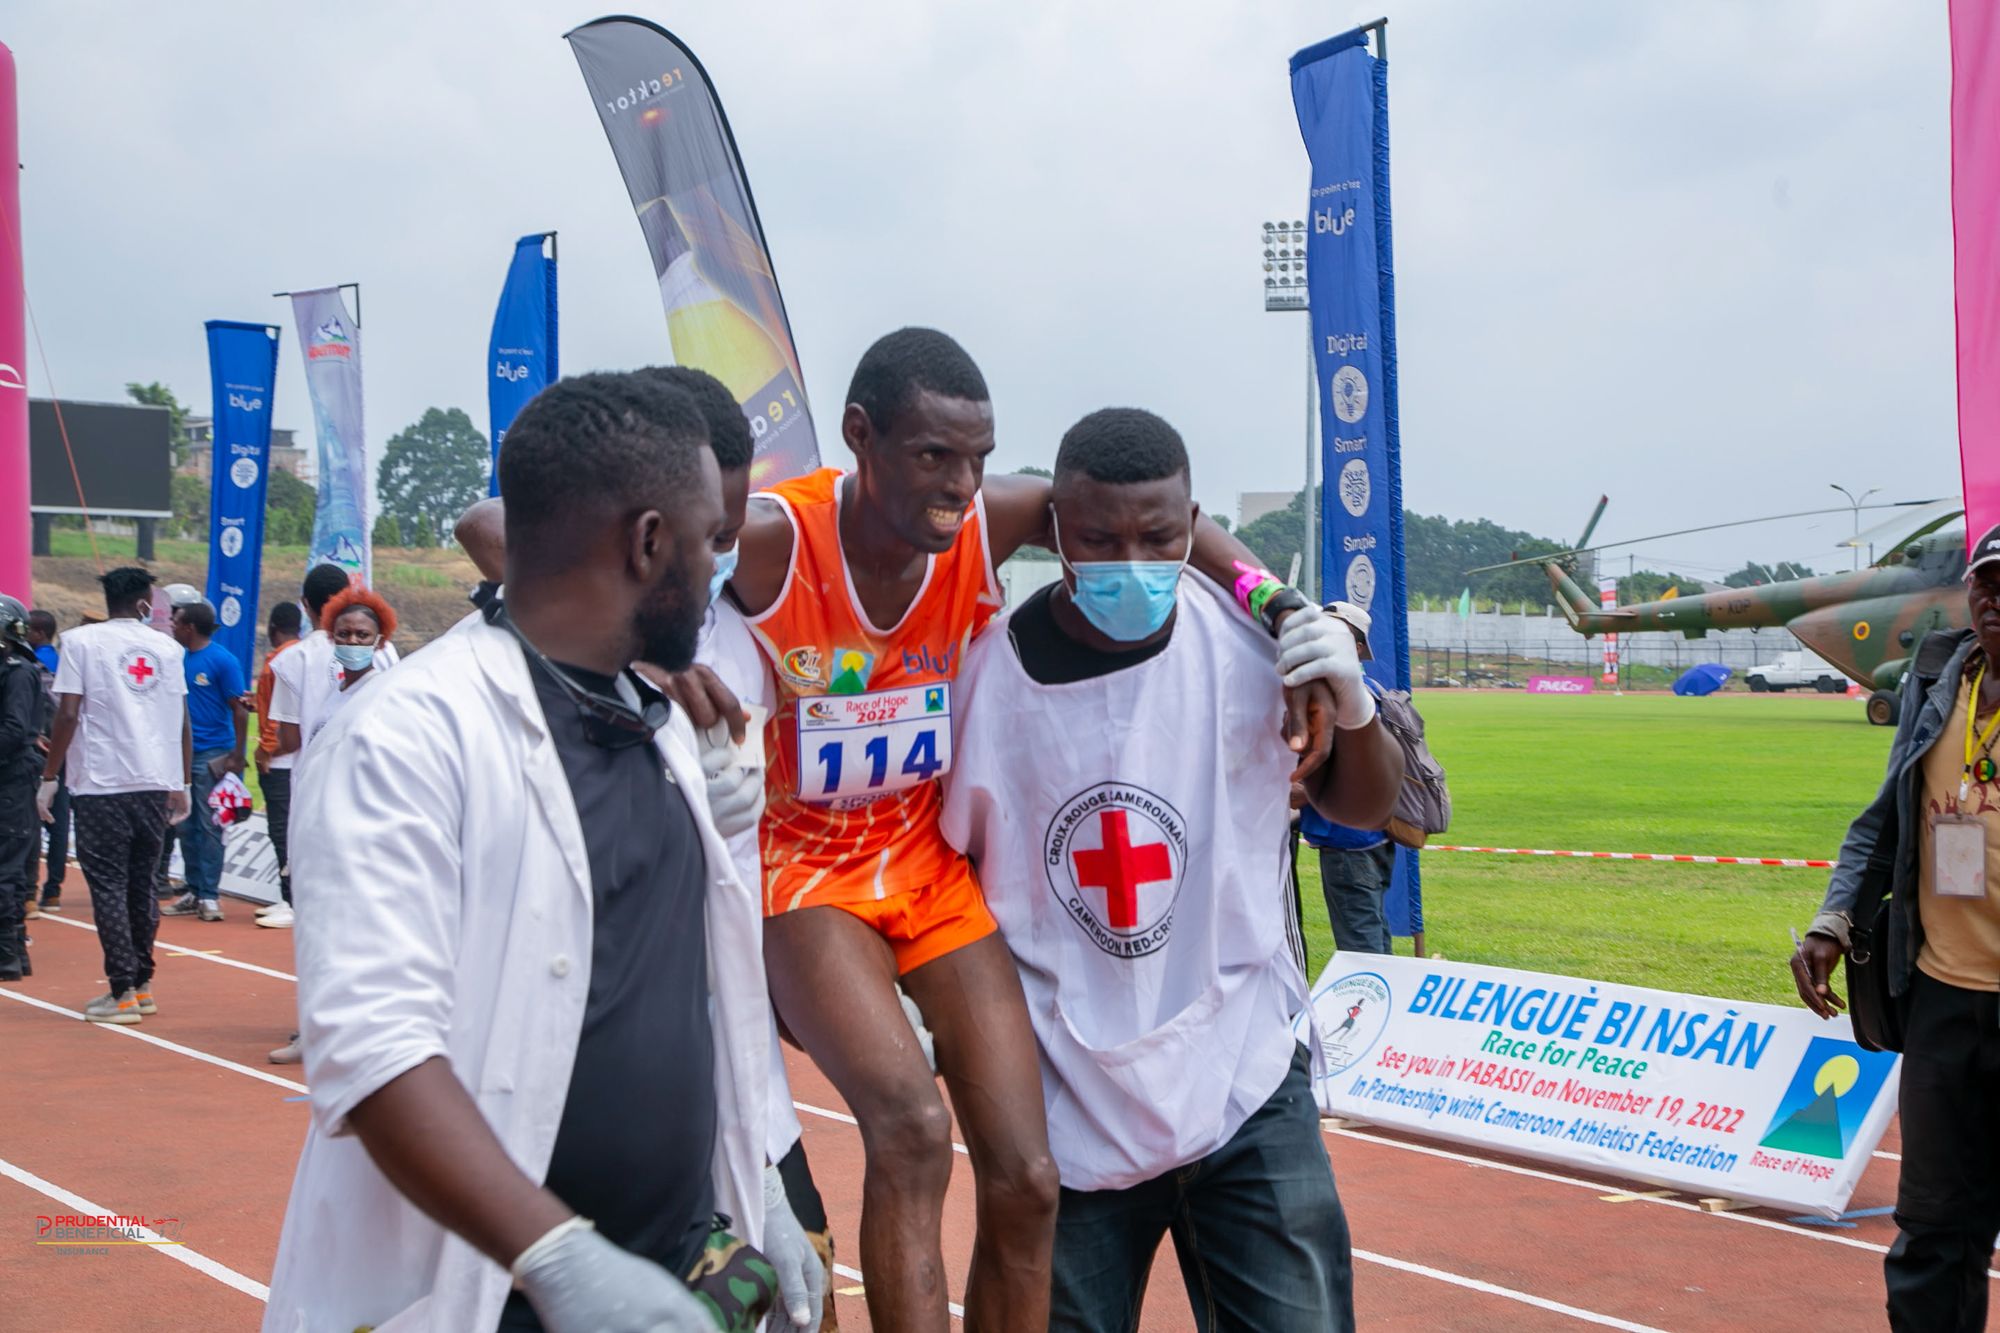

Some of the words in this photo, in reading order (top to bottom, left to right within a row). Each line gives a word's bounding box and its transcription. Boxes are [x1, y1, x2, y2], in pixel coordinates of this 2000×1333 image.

[1314, 207, 1356, 235] blue
[1327, 333, 1368, 357] Digital
[496, 361, 529, 382] blue
[229, 393, 263, 412] blue
[903, 640, 957, 674] blu
[846, 701, 869, 713] Race
[871, 697, 881, 710] of
[884, 696, 908, 710] Hope
[856, 707, 897, 724] 2022
[818, 729, 943, 794] 114
[1049, 791, 1108, 866] CROIX-ROUGE
[1068, 897, 1121, 952] CAMEROON
[1593, 1001, 1647, 1048] BI
[1480, 1030, 1537, 1061] Race
[1539, 1039, 1577, 1067] for
[1577, 1047, 1648, 1080] Peace
[1376, 1045, 1408, 1070] See
[1400, 1054, 1440, 1079] you
[1436, 1054, 1457, 1078] in
[1456, 1058, 1536, 1094] YABASSI
[1531, 1077, 1559, 1101] on
[1557, 1078, 1654, 1116] November
[1654, 1095, 1684, 1127] 19,
[1686, 1102, 1745, 1134] 2022
[1348, 1074, 1368, 1097] In
[1362, 1077, 1447, 1119] Partnership
[1448, 1094, 1485, 1121] with
[1484, 1101, 1565, 1138] Cameroon
[1561, 1117, 1640, 1152] Athletics
[1636, 1130, 1738, 1173] Federation
[1749, 1150, 1783, 1171] Race
[1782, 1157, 1802, 1174] of
[1798, 1159, 1835, 1183] Hope
